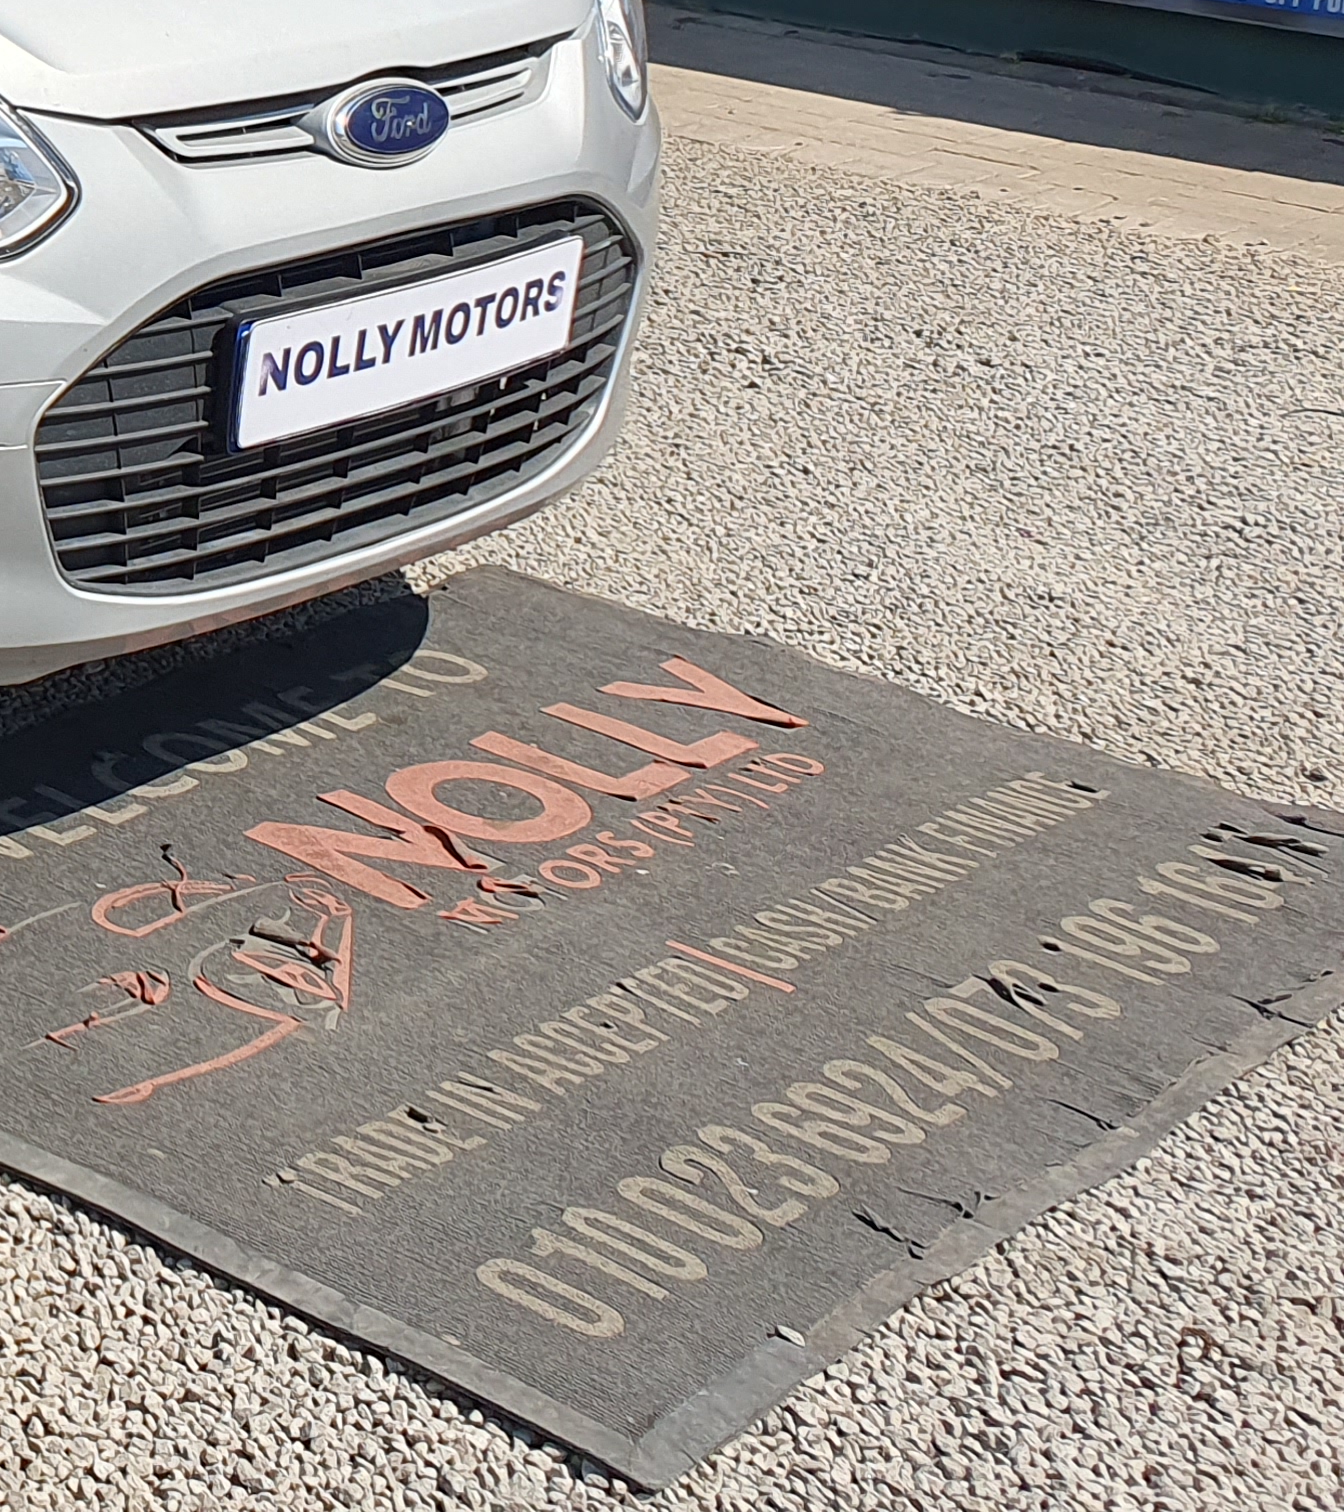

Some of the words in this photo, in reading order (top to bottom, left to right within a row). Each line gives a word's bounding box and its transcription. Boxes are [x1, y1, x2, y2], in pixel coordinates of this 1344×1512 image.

[370, 94, 432, 143] Ford
[258, 318, 405, 397] NOLLY
[407, 270, 567, 358] MOTORS
[331, 645, 490, 699] TO
[242, 653, 810, 909] NOLLY
[272, 1103, 487, 1217] TRADE
[426, 1070, 542, 1131] IN
[487, 953, 750, 1094] ACCEPTED
[712, 835, 971, 970] CASH/BANK
[918, 771, 1112, 859] FINANCE
[474, 1206, 710, 1339] 010
[615, 1124, 841, 1253] 023
[1037, 896, 1221, 986] 196
[1136, 822, 1330, 926] 16
